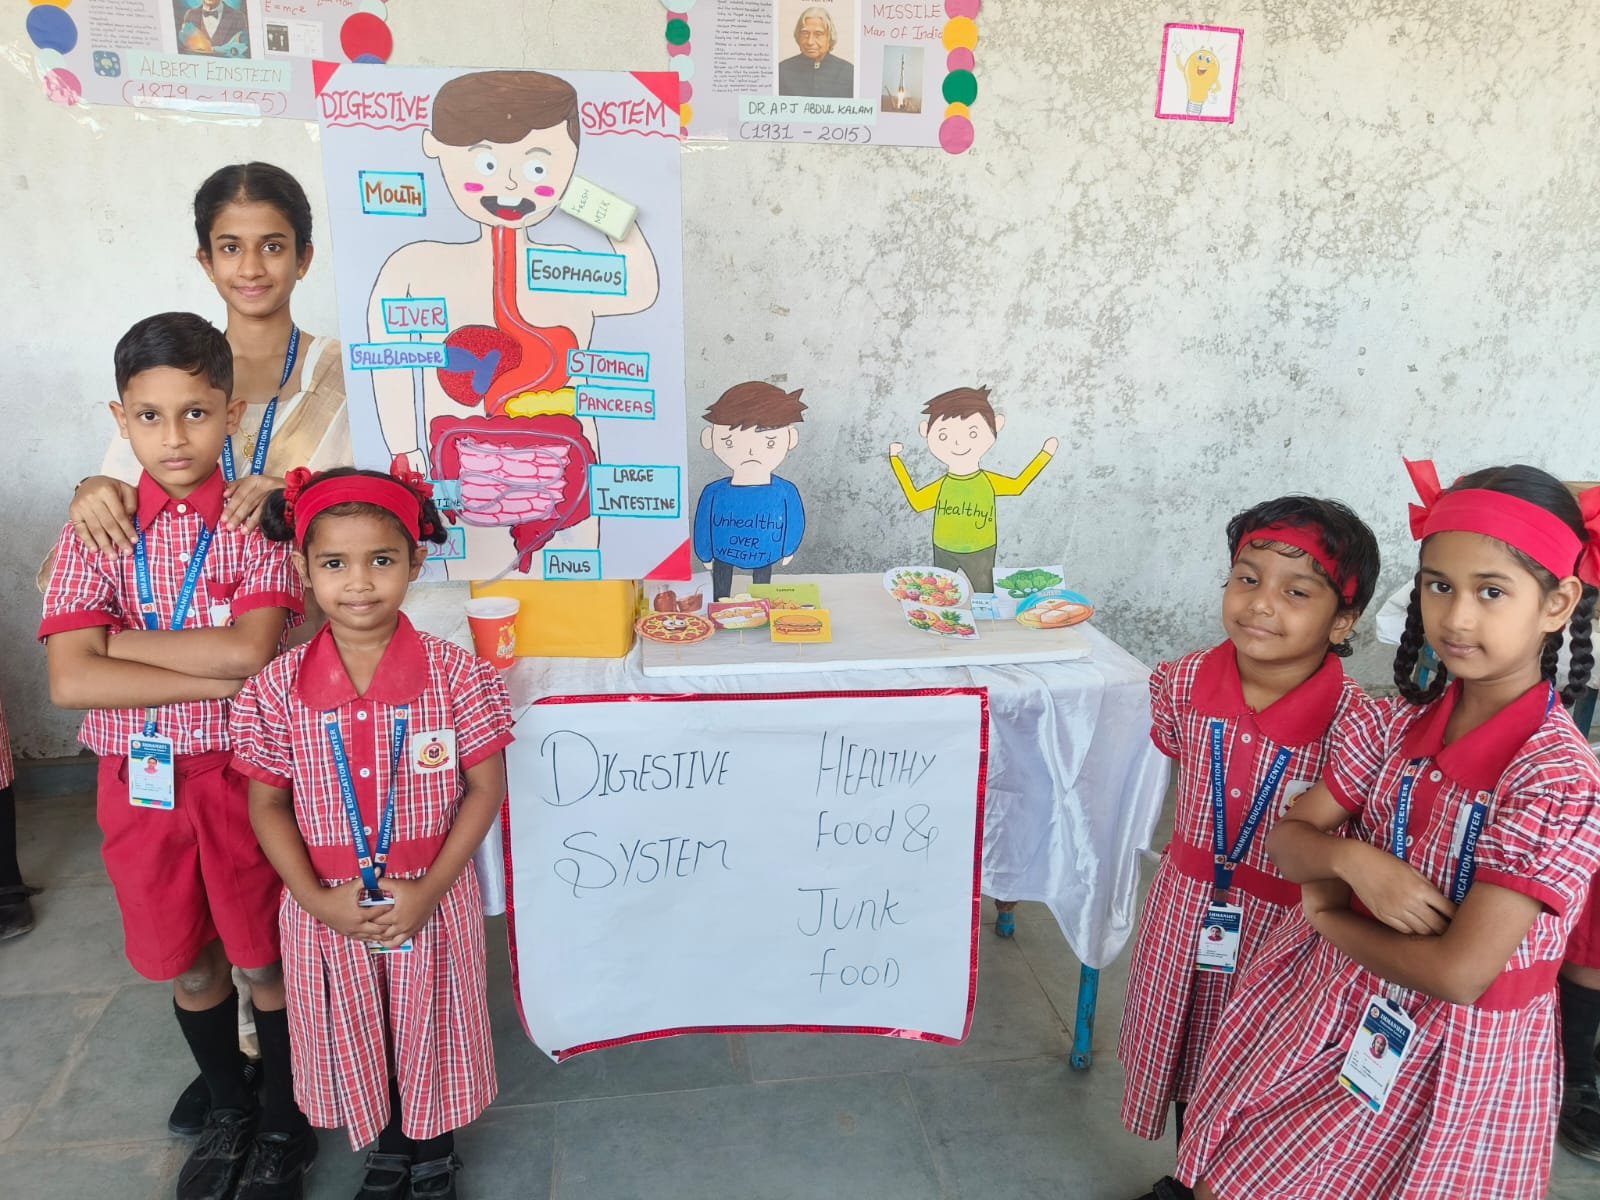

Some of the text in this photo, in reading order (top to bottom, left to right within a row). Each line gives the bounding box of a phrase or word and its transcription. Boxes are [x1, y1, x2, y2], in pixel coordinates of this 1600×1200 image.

[873, 4, 941, 19] MISSILE
[864, 25, 885, 37] Man
[891, 26, 908, 38] Of
[140, 55, 283, 82] ALBERT EINSTEIN
[320, 90, 430, 122] DIGESTIVE
[581, 99, 665, 130] SYSTEM
[804, 103, 835, 114] ABDUL
[837, 104, 873, 115] KALAM
[740, 122, 794, 140] (1931
[817, 125, 872, 143] 2015)
[365, 181, 422, 207] MOUTH
[531, 259, 623, 286] ESOPHAGUS
[388, 306, 446, 327] LIVER
[351, 344, 444, 365] GALLBLADDER
[570, 351, 645, 377] STOMACH
[578, 392, 653, 414] PANCREAS
[254, 429, 269, 469] EDUCATION
[613, 468, 654, 483] LARGE
[597, 487, 676, 511] INTESTINE
[713, 512, 784, 542] Unhealthy
[937, 499, 994, 530] Healthy!
[717, 547, 772, 562] WEIGHT!
[729, 535, 760, 549] OVER
[137, 555, 150, 598] IMMANUEL
[550, 554, 591, 574] ANUS
[174, 540, 208, 625] IMMANUEL EDUCATION
[394, 725, 403, 758] CENTER
[541, 730, 730, 807] DIGESTIVE
[816, 731, 936, 797] HEALTHY
[329, 728, 366, 853] IMMANUEL EDUCATION CENTER
[1213, 728, 1224, 850] IMMANUEL EDUCATION CENTER
[1398, 783, 1409, 823] CENTER
[1231, 754, 1287, 859] IMMANUEL EDUCATION CENTER
[381, 808, 393, 849] IMMANUEL
[902, 803, 940, 862] &
[1466, 811, 1482, 851] CENTER
[553, 830, 732, 899] SYSTEM
